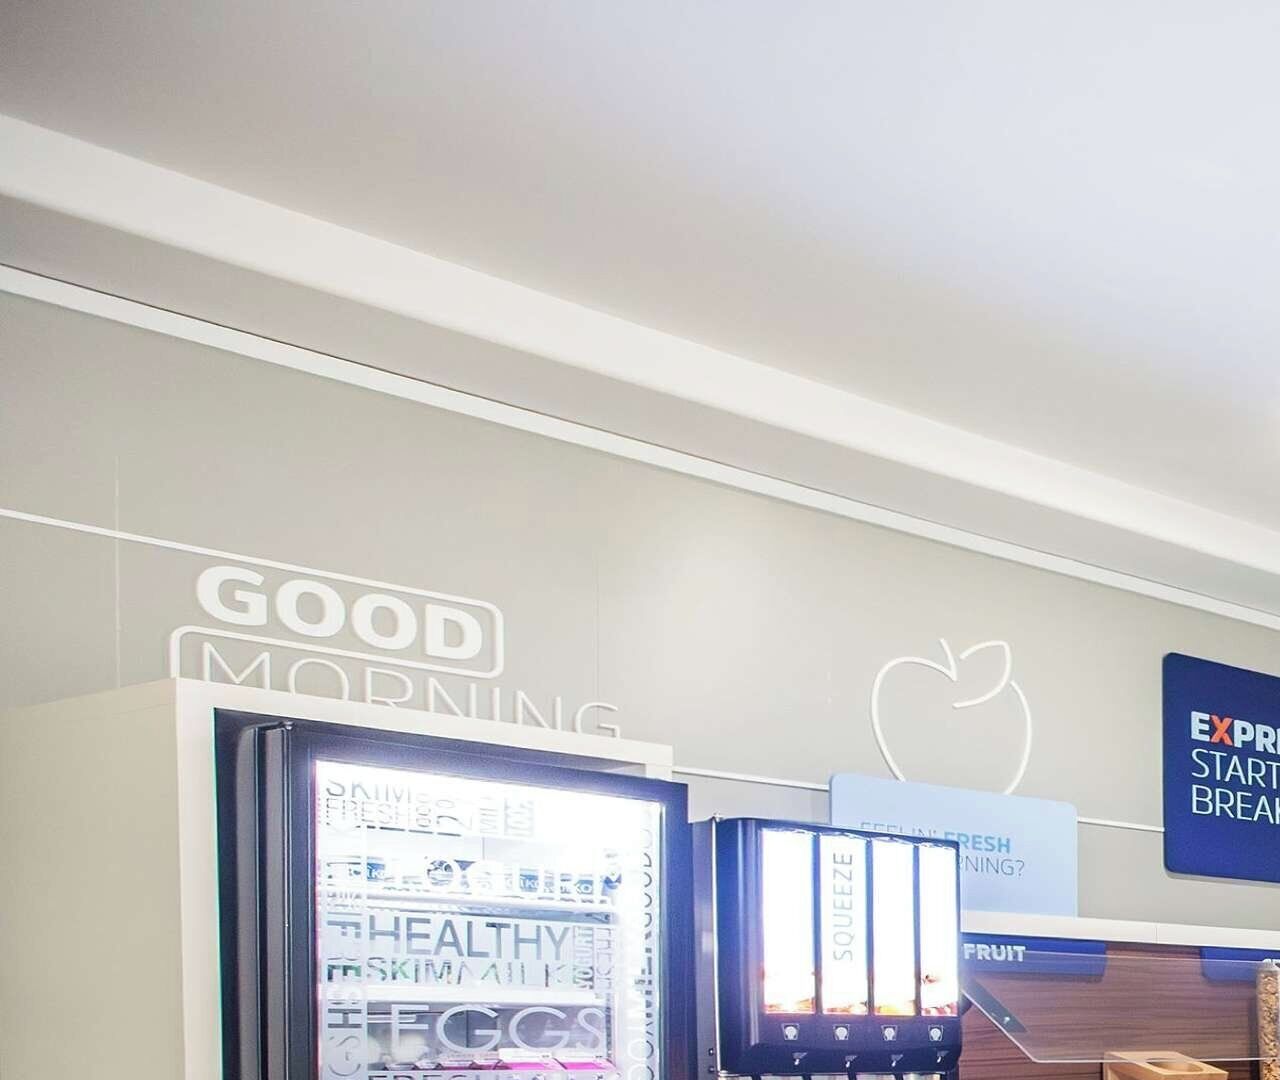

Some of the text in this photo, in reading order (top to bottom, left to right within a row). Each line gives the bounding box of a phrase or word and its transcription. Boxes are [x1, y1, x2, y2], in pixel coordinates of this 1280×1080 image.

[196, 565, 483, 660] GOOD
[202, 641, 622, 738] MORNING
[368, 914, 570, 960] HEALTHY
[833, 852, 854, 961] SQUEEZE
[963, 943, 1026, 962] FRUIT
